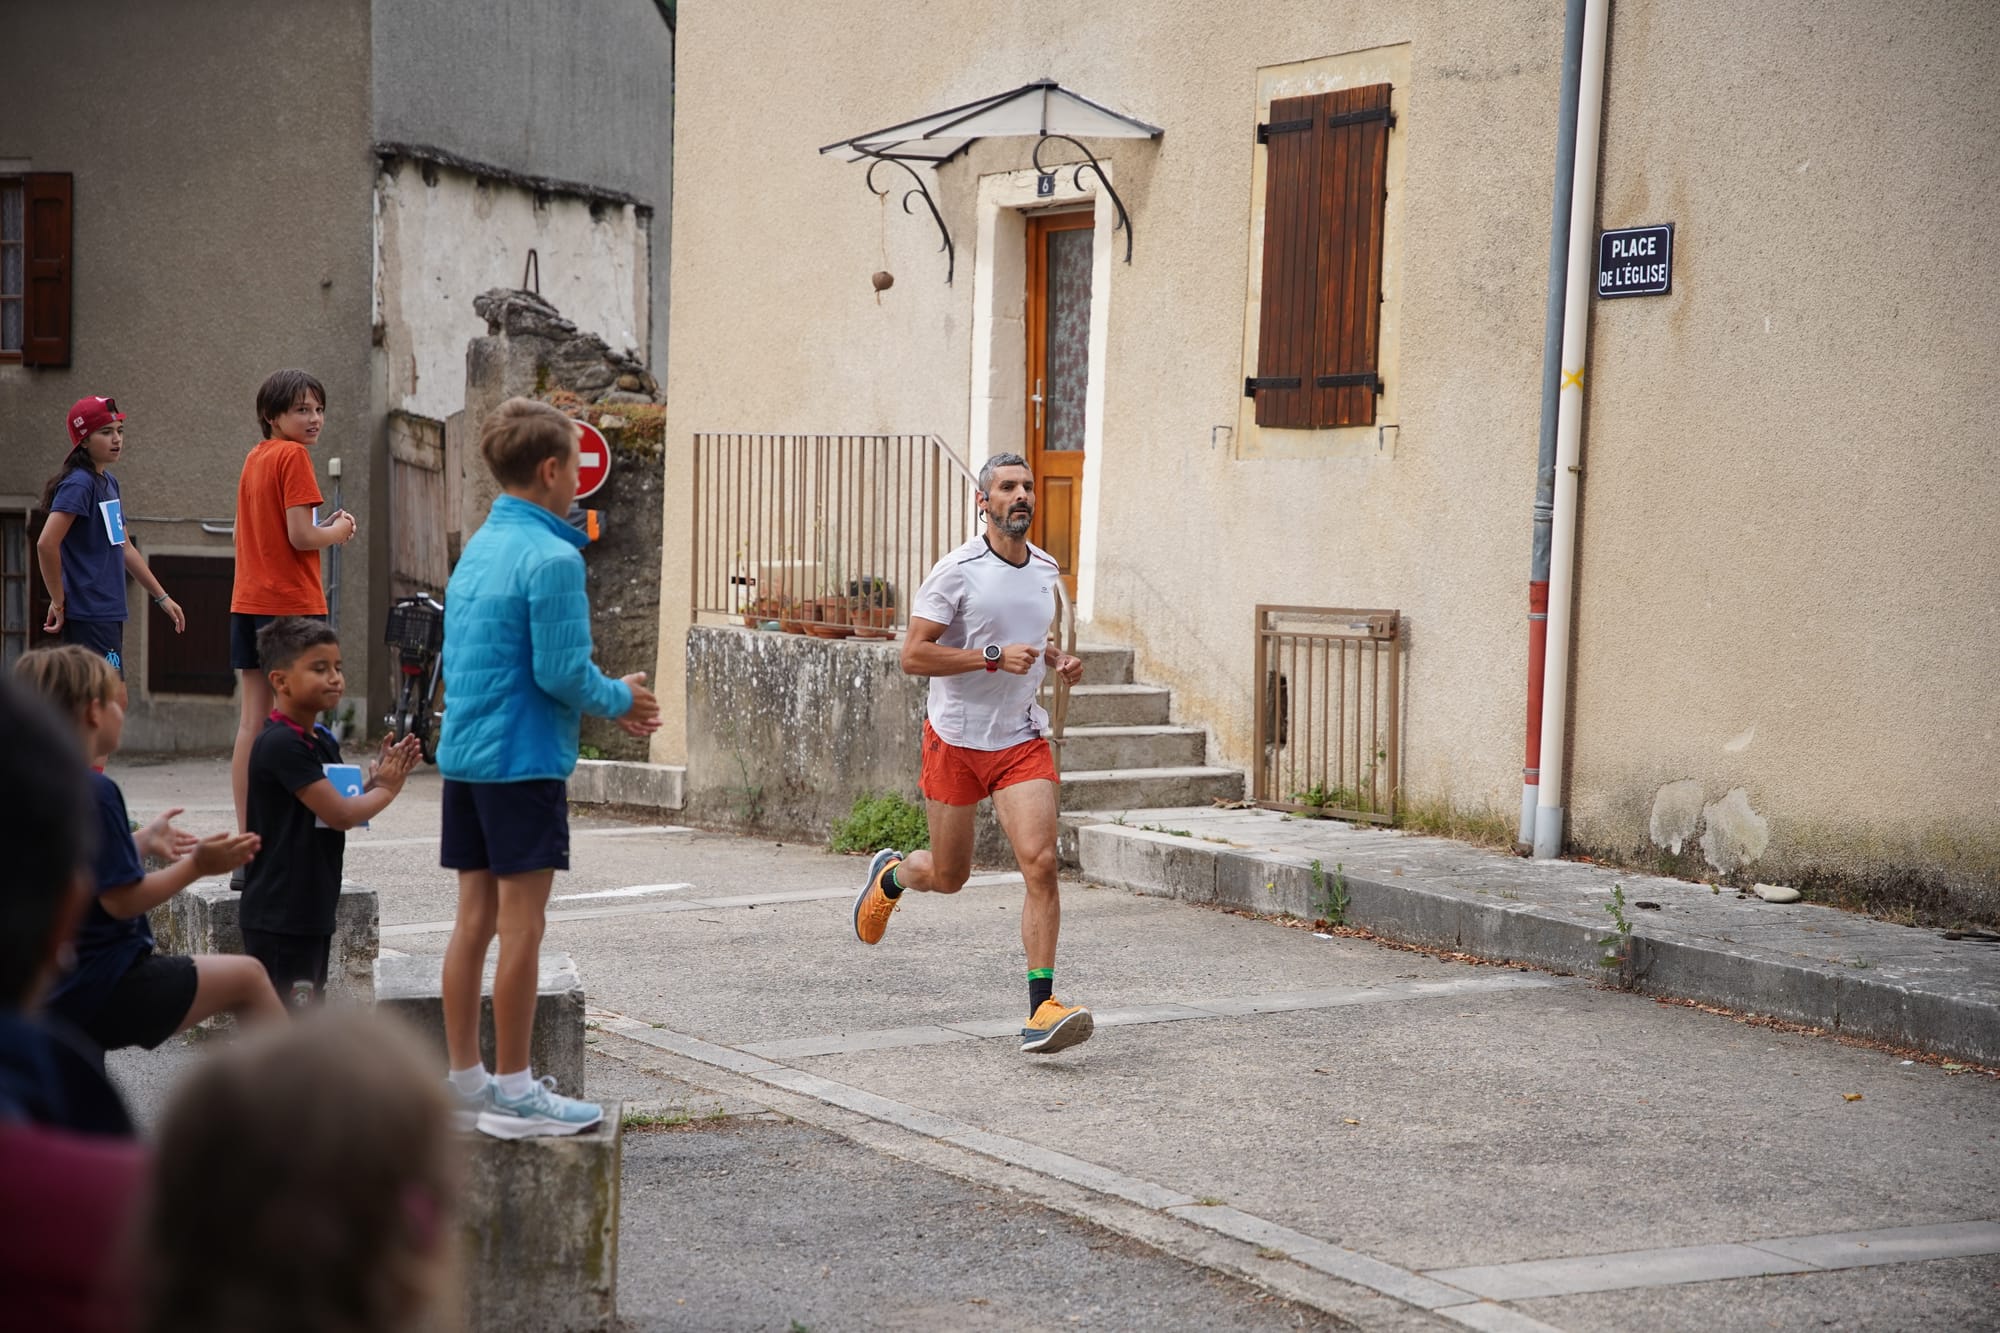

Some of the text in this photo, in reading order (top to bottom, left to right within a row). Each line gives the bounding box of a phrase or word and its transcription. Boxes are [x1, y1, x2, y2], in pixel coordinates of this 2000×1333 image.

[1042, 177, 1049, 193] 6
[1612, 237, 1656, 258] PLACE
[1601, 262, 1666, 287] DE L'ÉGLISE
